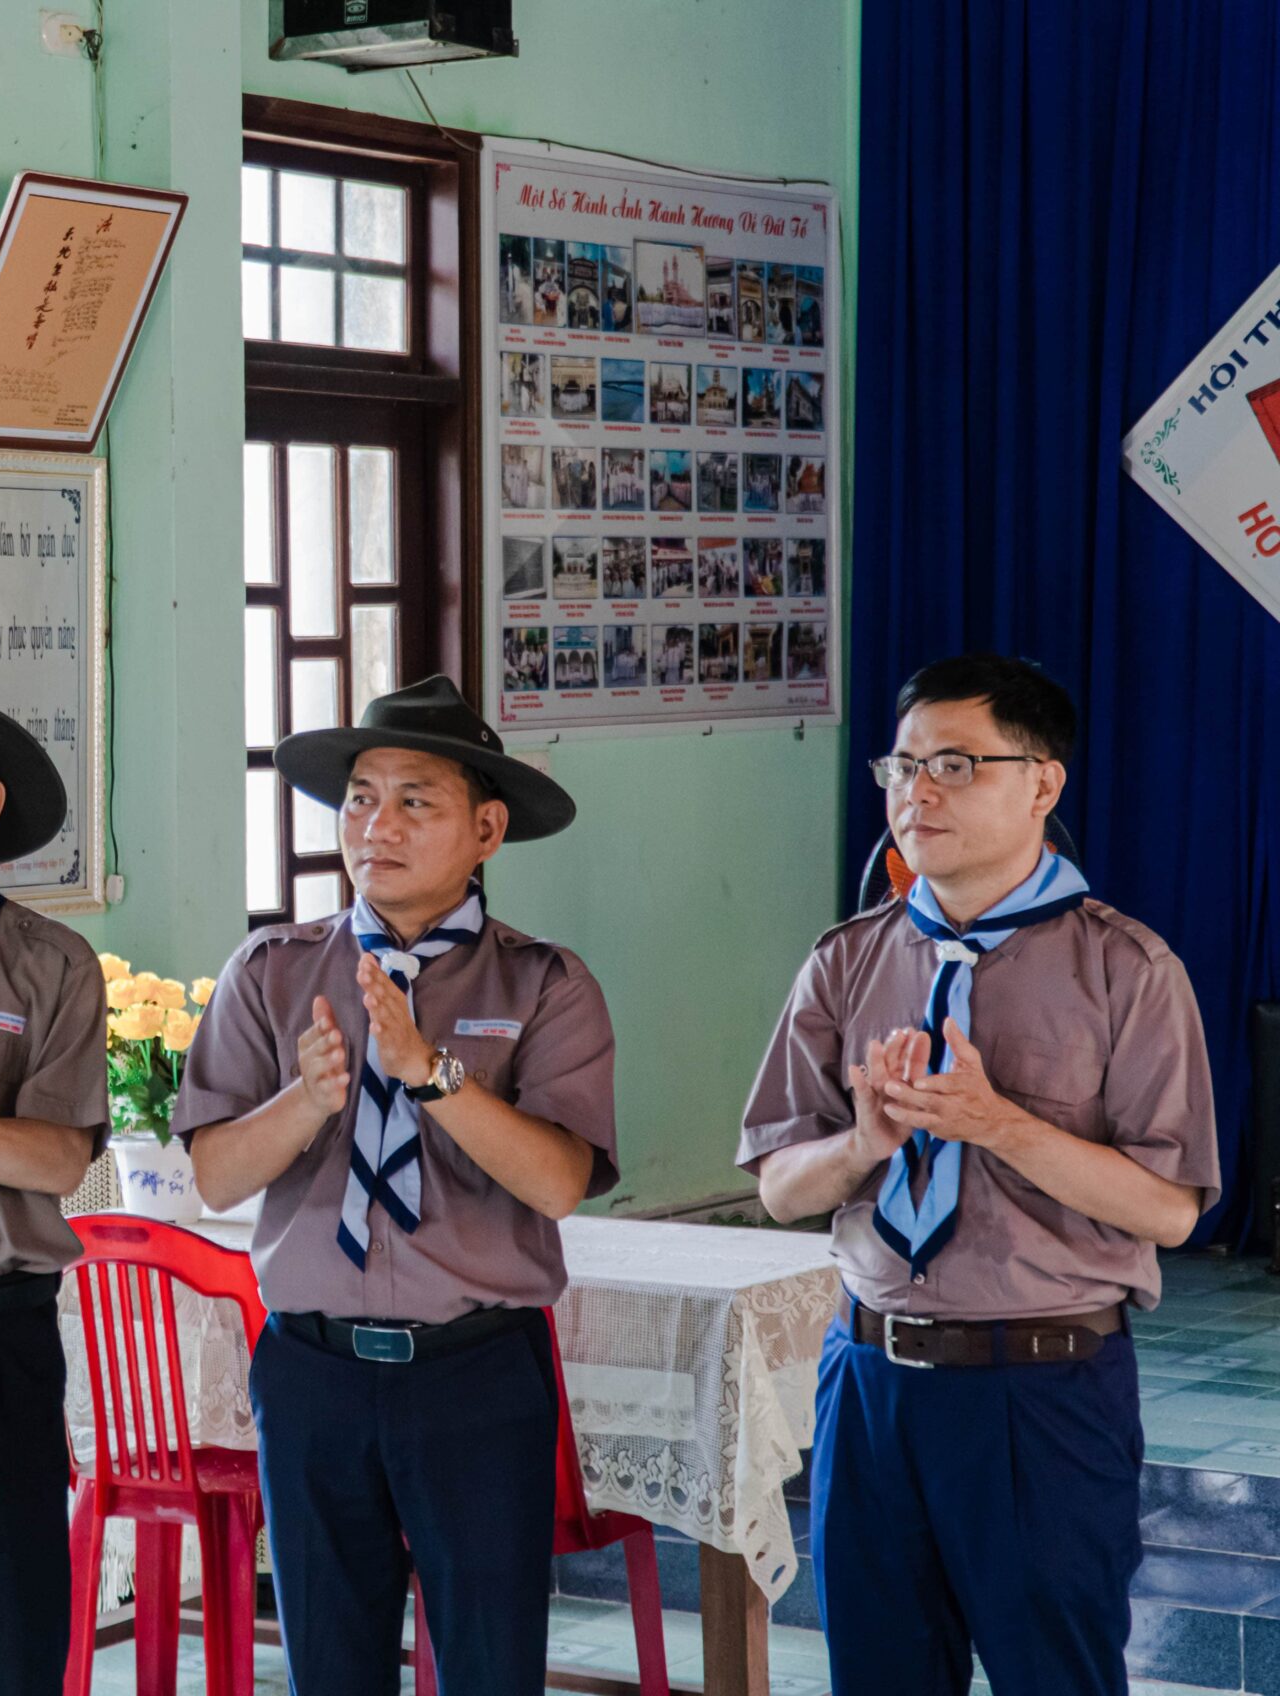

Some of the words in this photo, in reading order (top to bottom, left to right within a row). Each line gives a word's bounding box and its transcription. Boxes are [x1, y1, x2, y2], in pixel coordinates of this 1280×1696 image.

[517, 183, 545, 212] Một
[548, 187, 567, 212] Số
[572, 190, 608, 217] Hình
[612, 187, 643, 221] Ảnh
[1188, 348, 1251, 415] HỘI
